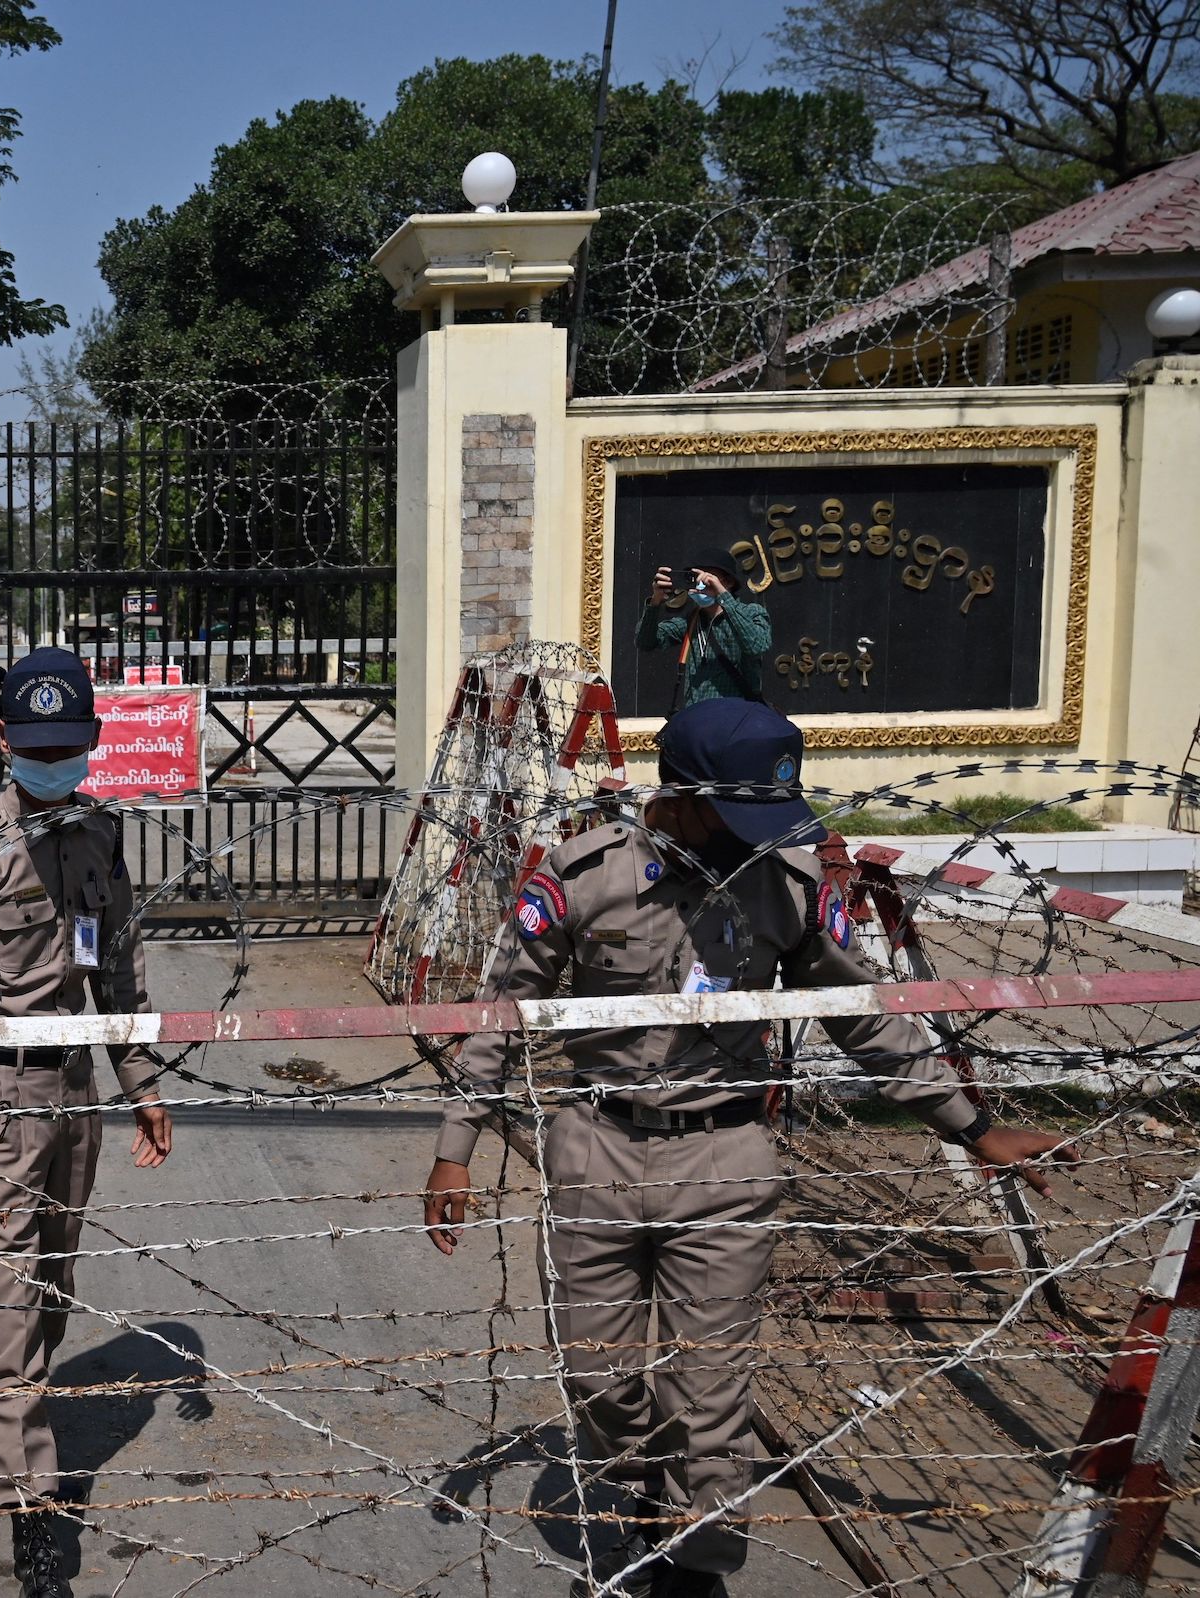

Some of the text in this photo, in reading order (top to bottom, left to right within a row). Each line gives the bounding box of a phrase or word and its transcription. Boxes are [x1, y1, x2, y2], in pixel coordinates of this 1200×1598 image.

[775, 636, 875, 689] ရန်ကုန်
[15, 675, 78, 701] PRISONS DEPARTMENT
